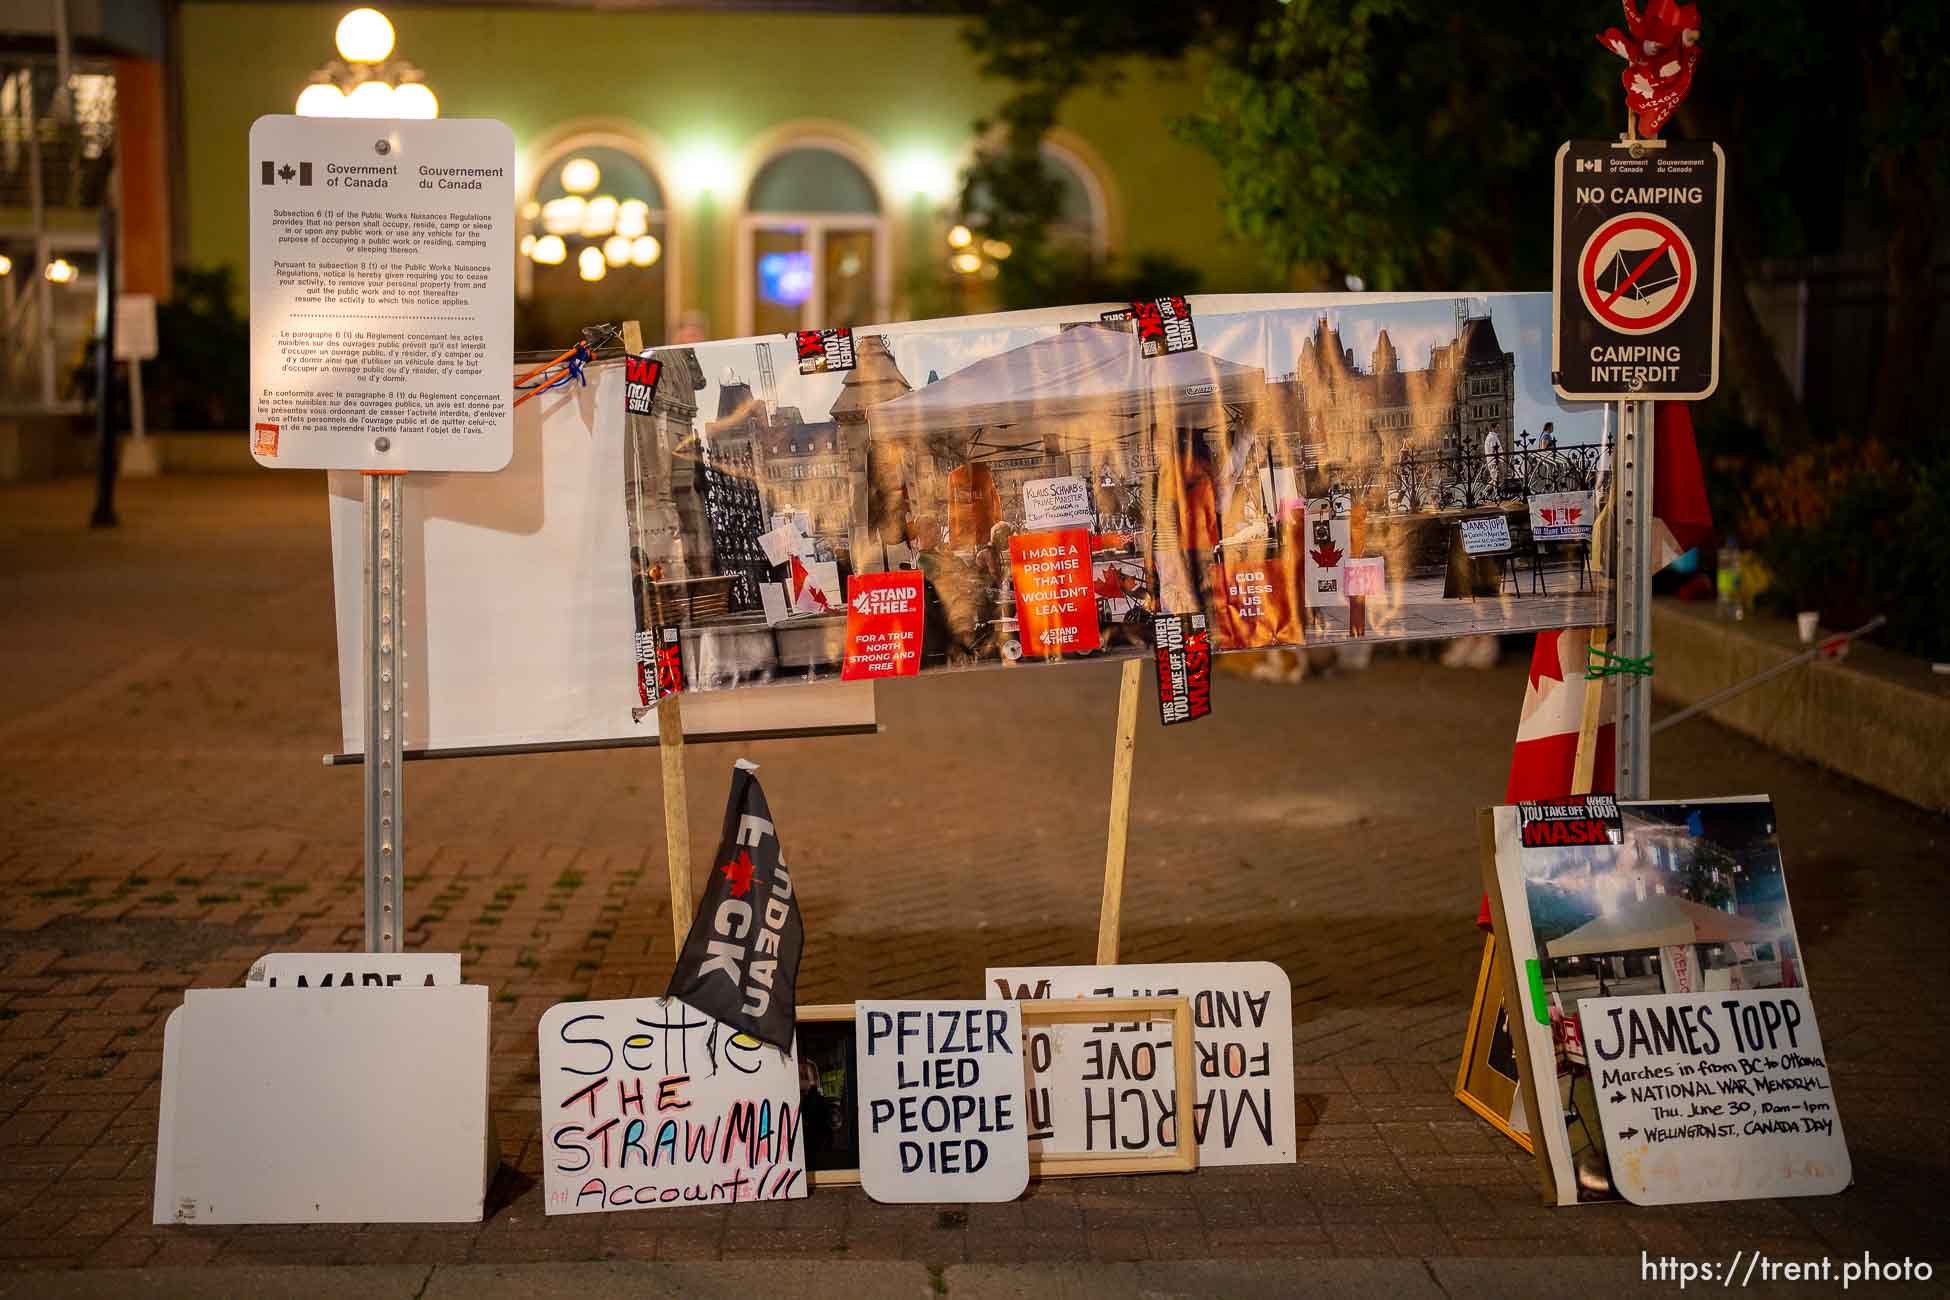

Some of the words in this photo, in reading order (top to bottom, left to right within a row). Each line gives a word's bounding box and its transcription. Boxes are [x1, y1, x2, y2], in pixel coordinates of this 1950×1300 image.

[327, 163, 397, 175] Government
[419, 165, 503, 177] Gouvernement
[327, 177, 338, 188] of
[344, 178, 388, 188] Canada
[419, 178, 433, 189] du
[438, 179, 482, 190] Canada
[1576, 188, 1604, 203] NO
[1611, 187, 1703, 204] CAMPING
[1163, 319, 1182, 351] YOUR
[1179, 318, 1194, 348] WHEN
[823, 335, 841, 369] YOUR
[839, 336, 853, 367] WHEN
[1591, 346, 1681, 363] CAMPING
[1591, 366, 1680, 382] INTERDIT
[628, 383, 651, 401] YOU
[629, 399, 649, 413] THIS
[1022, 550, 1026, 560] I
[1029, 546, 1066, 559] MADE
[1069, 545, 1078, 554] A
[1024, 559, 1079, 574] PROMISE
[1033, 575, 1065, 588] THAT
[1069, 574, 1073, 583] I
[870, 587, 917, 602] STAND
[1022, 587, 1088, 602] WOULDN'T
[1230, 585, 1272, 596] BLESS
[1036, 603, 1078, 616] LEAVE.
[1243, 596, 1262, 605] US
[1240, 608, 1264, 616] ALL
[856, 634, 876, 643] FOR
[887, 632, 914, 641] TRUE
[1049, 627, 1078, 637] STAND
[1155, 618, 1168, 649] WHEN
[1167, 616, 1183, 652] YOUR
[641, 627, 655, 666] YOUR
[866, 642, 901, 652] NORTH
[849, 653, 890, 664] STRONG
[892, 651, 915, 660] AND
[868, 662, 894, 671] FREE
[1170, 653, 1182, 669] OFF
[645, 668, 655, 686] OFF
[1158, 650, 1173, 702] ENDS
[1172, 671, 1184, 696] TAKE
[1184, 630, 1209, 719] MASK
[1163, 702, 1175, 723] THIS
[1174, 694, 1189, 721] YOU
[1586, 796, 1613, 806] WHEN
[1522, 806, 1542, 820] YOU
[1543, 806, 1568, 817] TAKE
[1568, 806, 1584, 816] OFF
[1585, 805, 1618, 818] YOUR
[1525, 820, 1609, 845] MASK
[1194, 990, 1270, 1028] AND
[867, 1009, 1013, 1056] PFIZER
[1595, 1004, 1720, 1061] JAMES
[1722, 999, 1802, 1053] TOPP
[1194, 1041, 1270, 1078] FOR
[897, 1058, 980, 1089] LIED
[1602, 1066, 1674, 1088] Marches
[1679, 1063, 1695, 1076] in
[1698, 1060, 1737, 1077] from
[1739, 1058, 1764, 1074] BC
[1764, 1059, 1778, 1071] to
[1781, 1054, 1825, 1070] Ottawa
[560, 1076, 691, 1117] THE
[1631, 1082, 1715, 1103] NATIONAL
[1717, 1078, 1754, 1097] WAR
[1754, 1076, 1829, 1093] MEMORIAL
[872, 1094, 1014, 1134] PEOPLE
[1084, 1087, 1273, 1150] MARCH
[1688, 1104, 1722, 1118] June
[553, 1099, 800, 1171] STRAWMAN
[1643, 1124, 1718, 1144] WELLINGTON
[1743, 1120, 1799, 1136] CANADA
[1802, 1118, 1833, 1136] DAY
[900, 1139, 988, 1174] DIED
